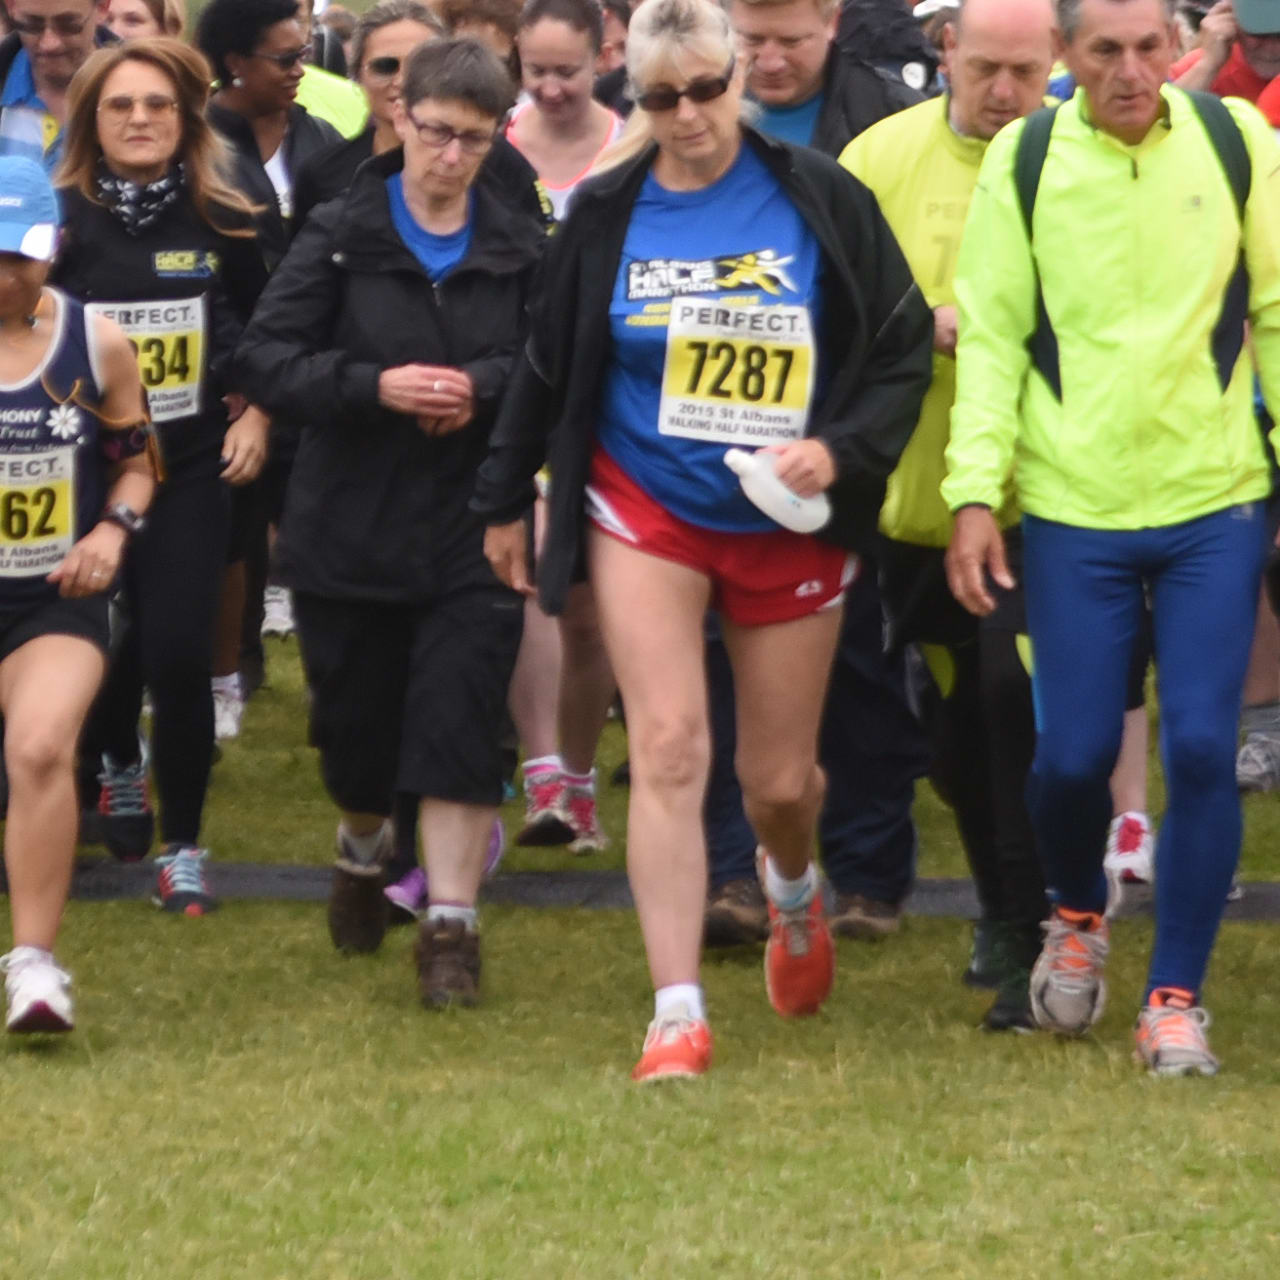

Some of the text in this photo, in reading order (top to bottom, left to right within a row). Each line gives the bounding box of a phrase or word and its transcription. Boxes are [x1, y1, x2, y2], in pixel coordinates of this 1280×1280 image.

[96, 306, 196, 325] ERFECT.
[141, 335, 191, 386] 34
[683, 341, 794, 404] 7287
[678, 403, 791, 424] 2015 St Albans
[667, 416, 799, 438] WALKING HALF MARATHON
[10, 543, 59, 557] Albans
